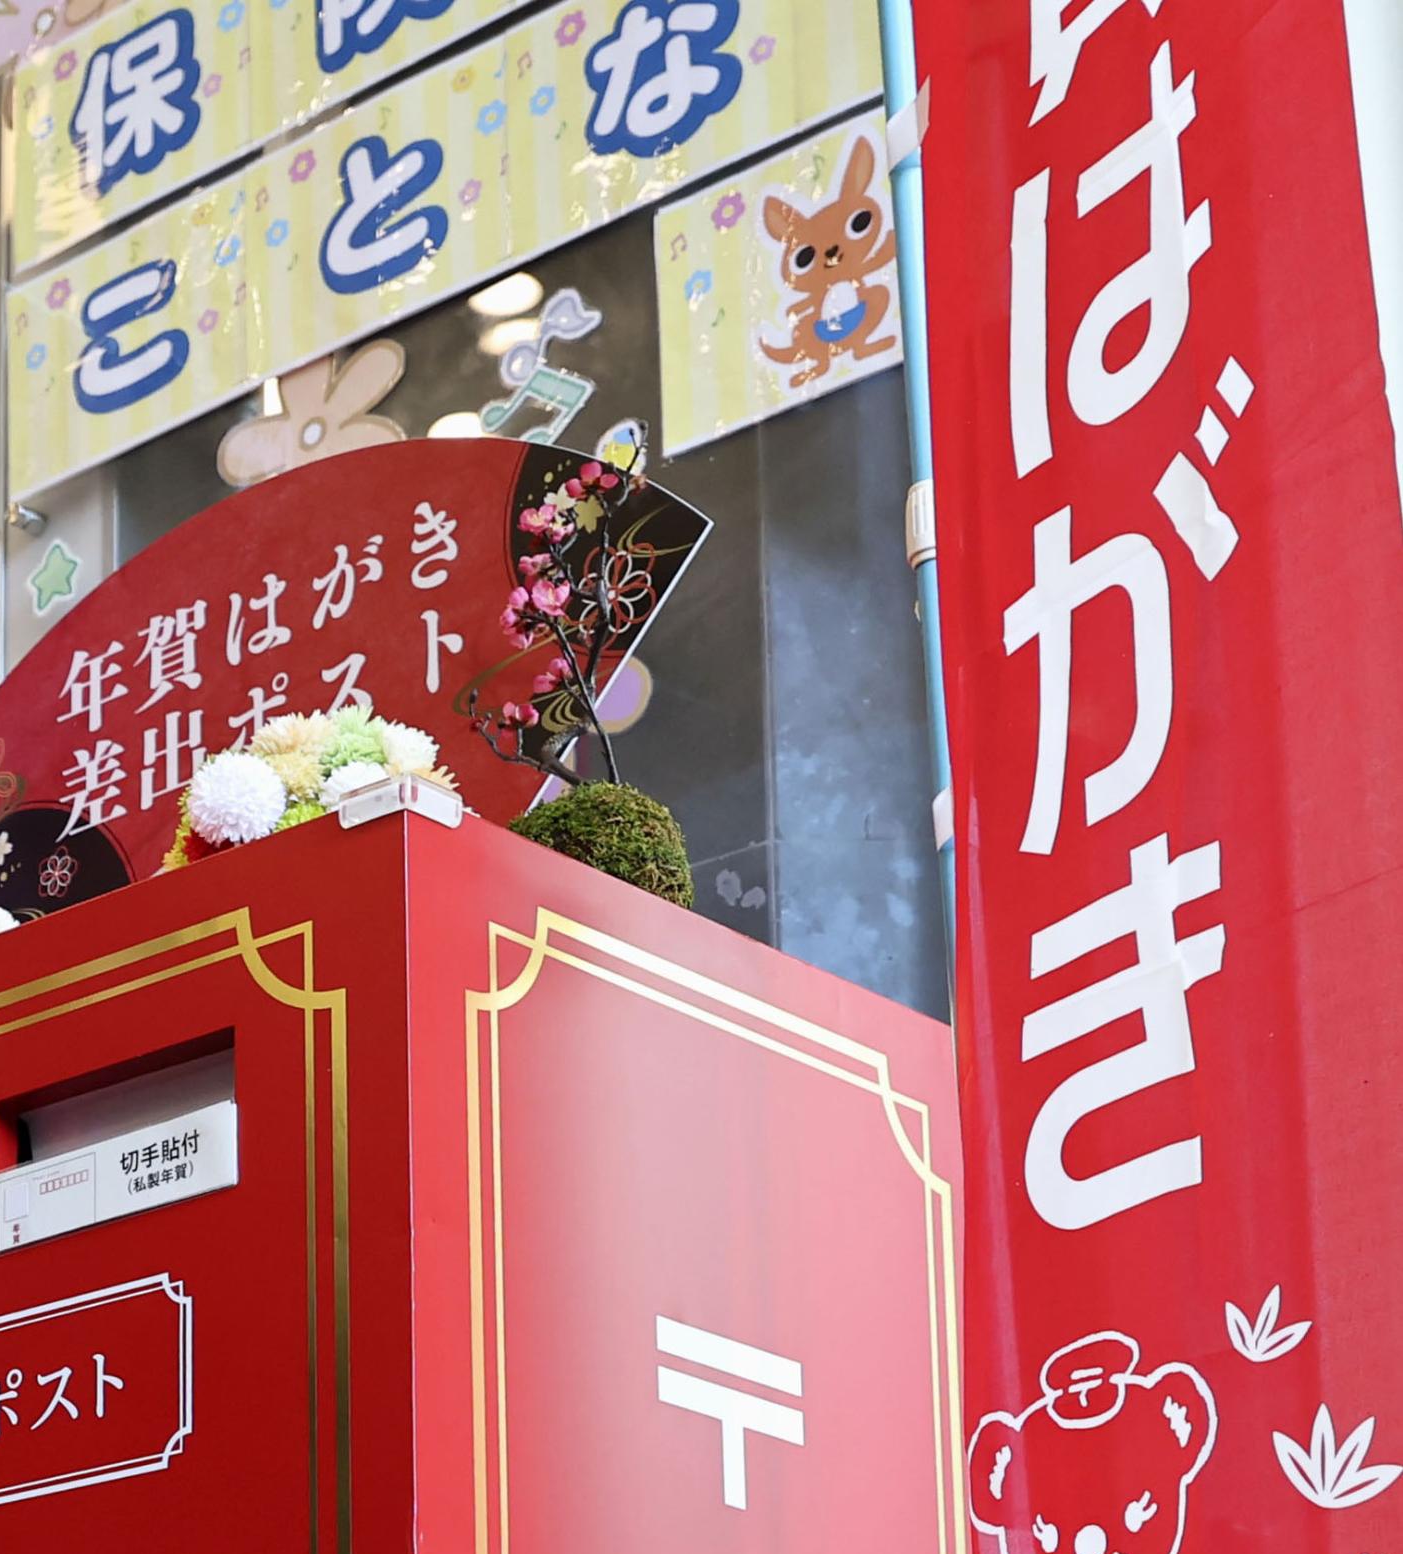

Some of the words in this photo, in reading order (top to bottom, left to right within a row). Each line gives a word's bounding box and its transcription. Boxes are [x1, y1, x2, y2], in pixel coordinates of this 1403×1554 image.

[55, 501, 460, 733] 年賀はがき
[55, 608, 464, 843] 差出ポスト
[119, 1128, 201, 1175] 切手貼付
